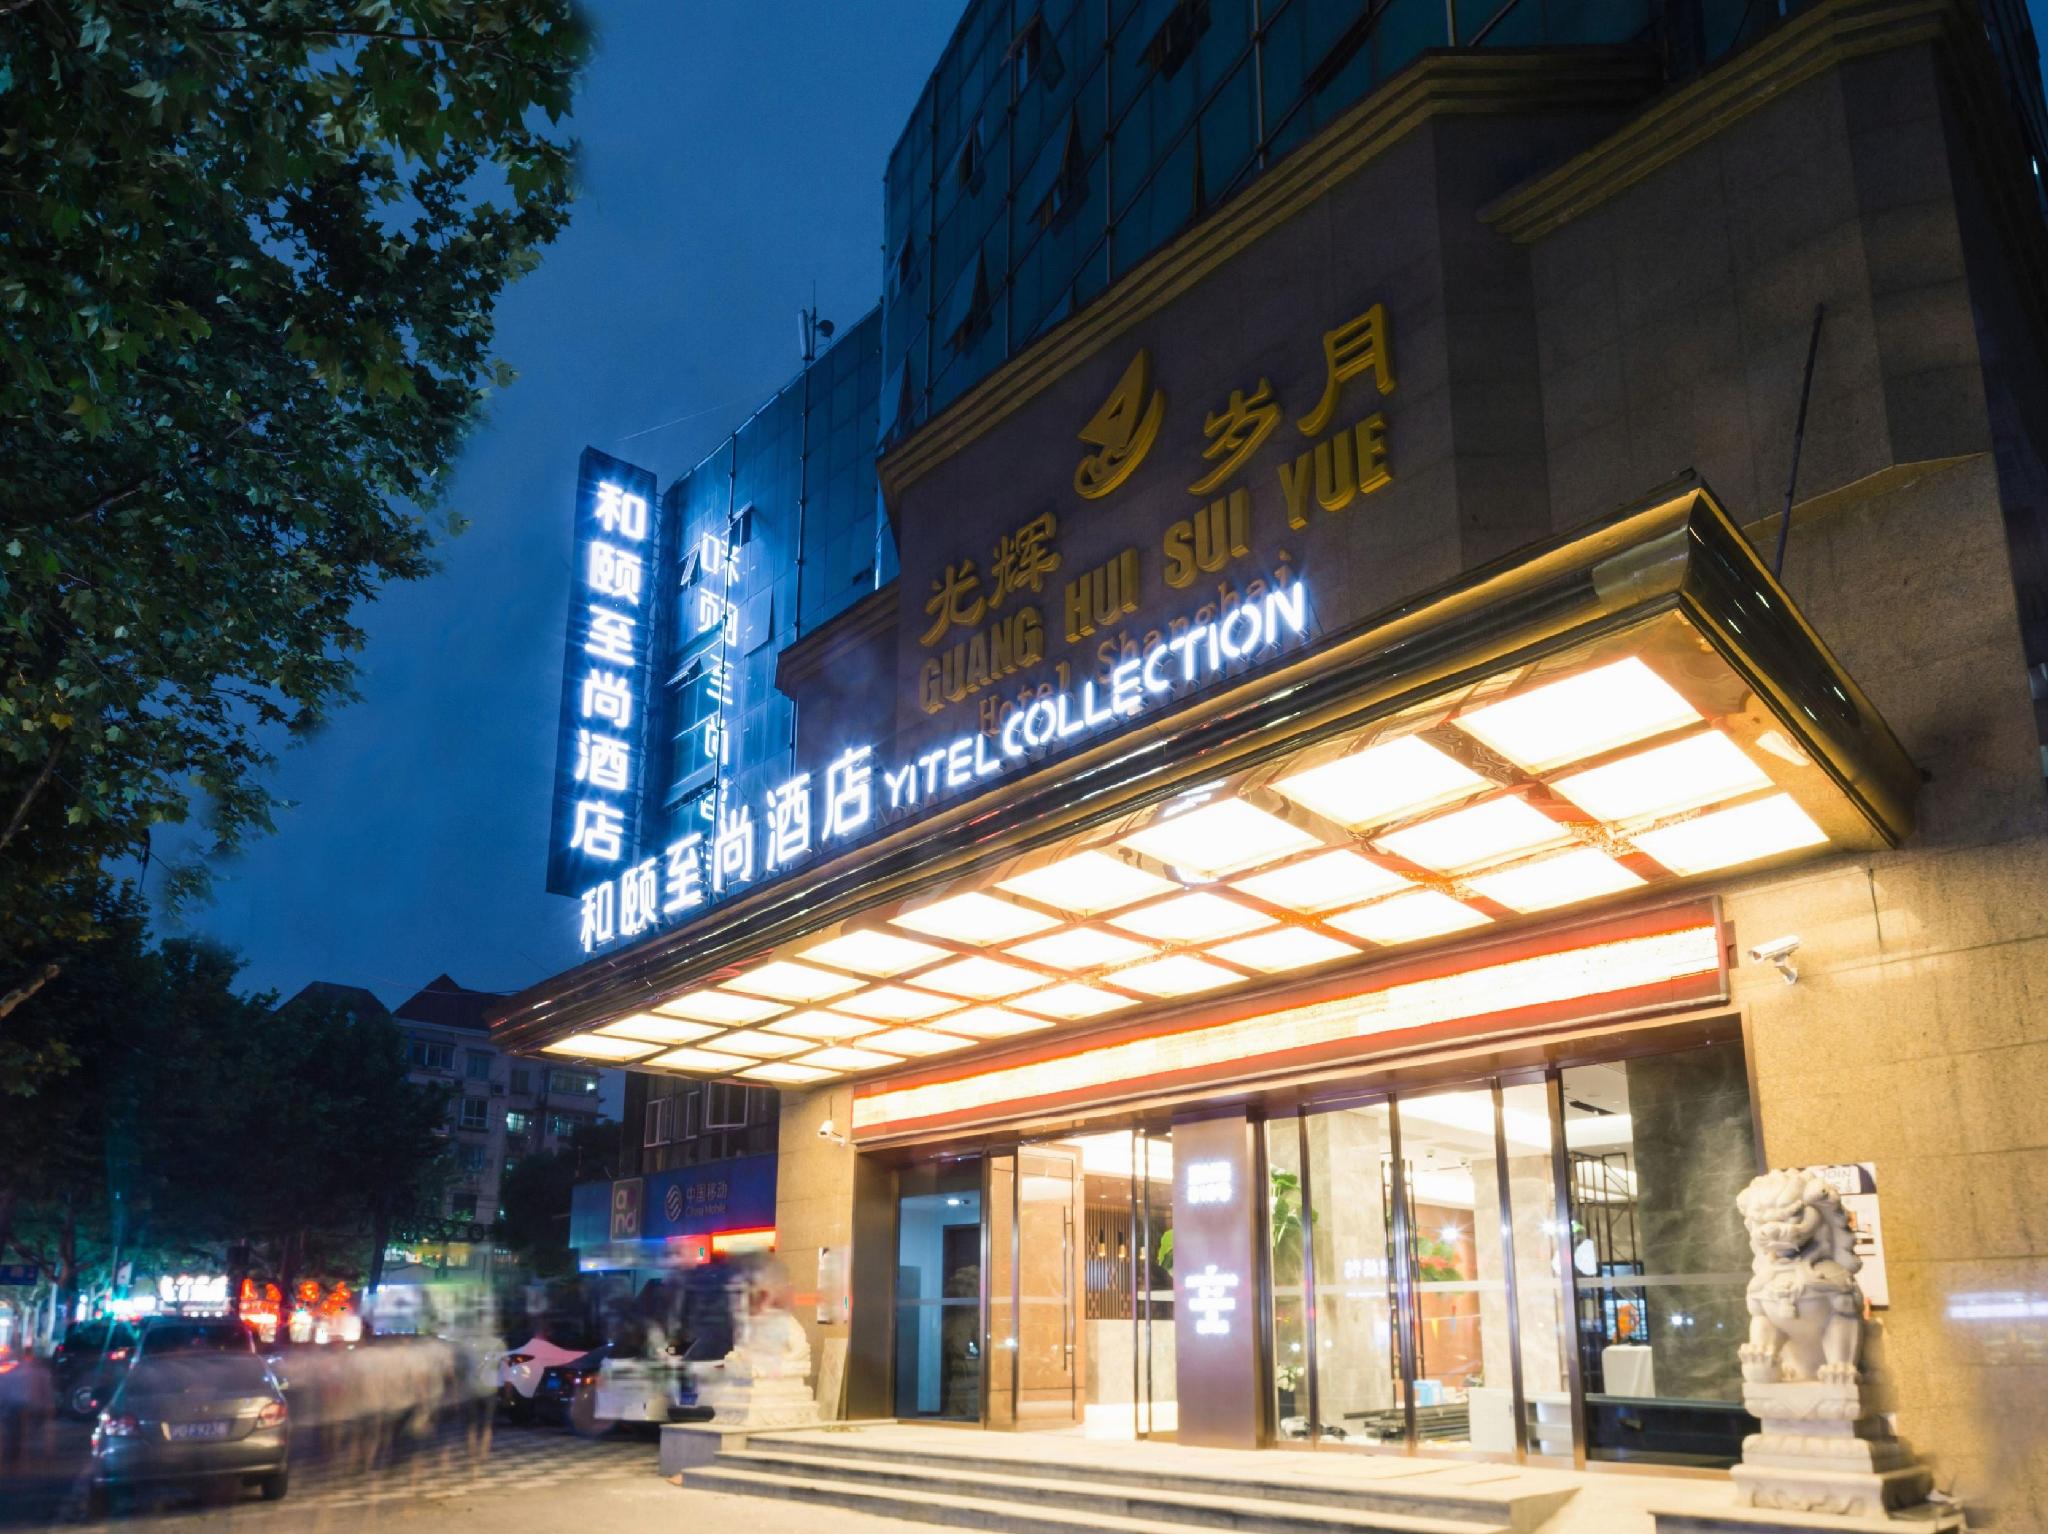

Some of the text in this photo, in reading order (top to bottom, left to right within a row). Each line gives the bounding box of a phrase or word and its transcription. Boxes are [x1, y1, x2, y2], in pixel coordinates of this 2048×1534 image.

[920, 303, 1395, 647] 光辉 岁月
[920, 412, 1393, 715] GUANG HUI SUI YUE
[570, 479, 647, 862] 和颐至尚酒店
[883, 583, 1304, 807] YITEL COLLECTION
[580, 745, 873, 952] 和颐至尚酒店
[686, 1182, 728, 1203] 中国移动
